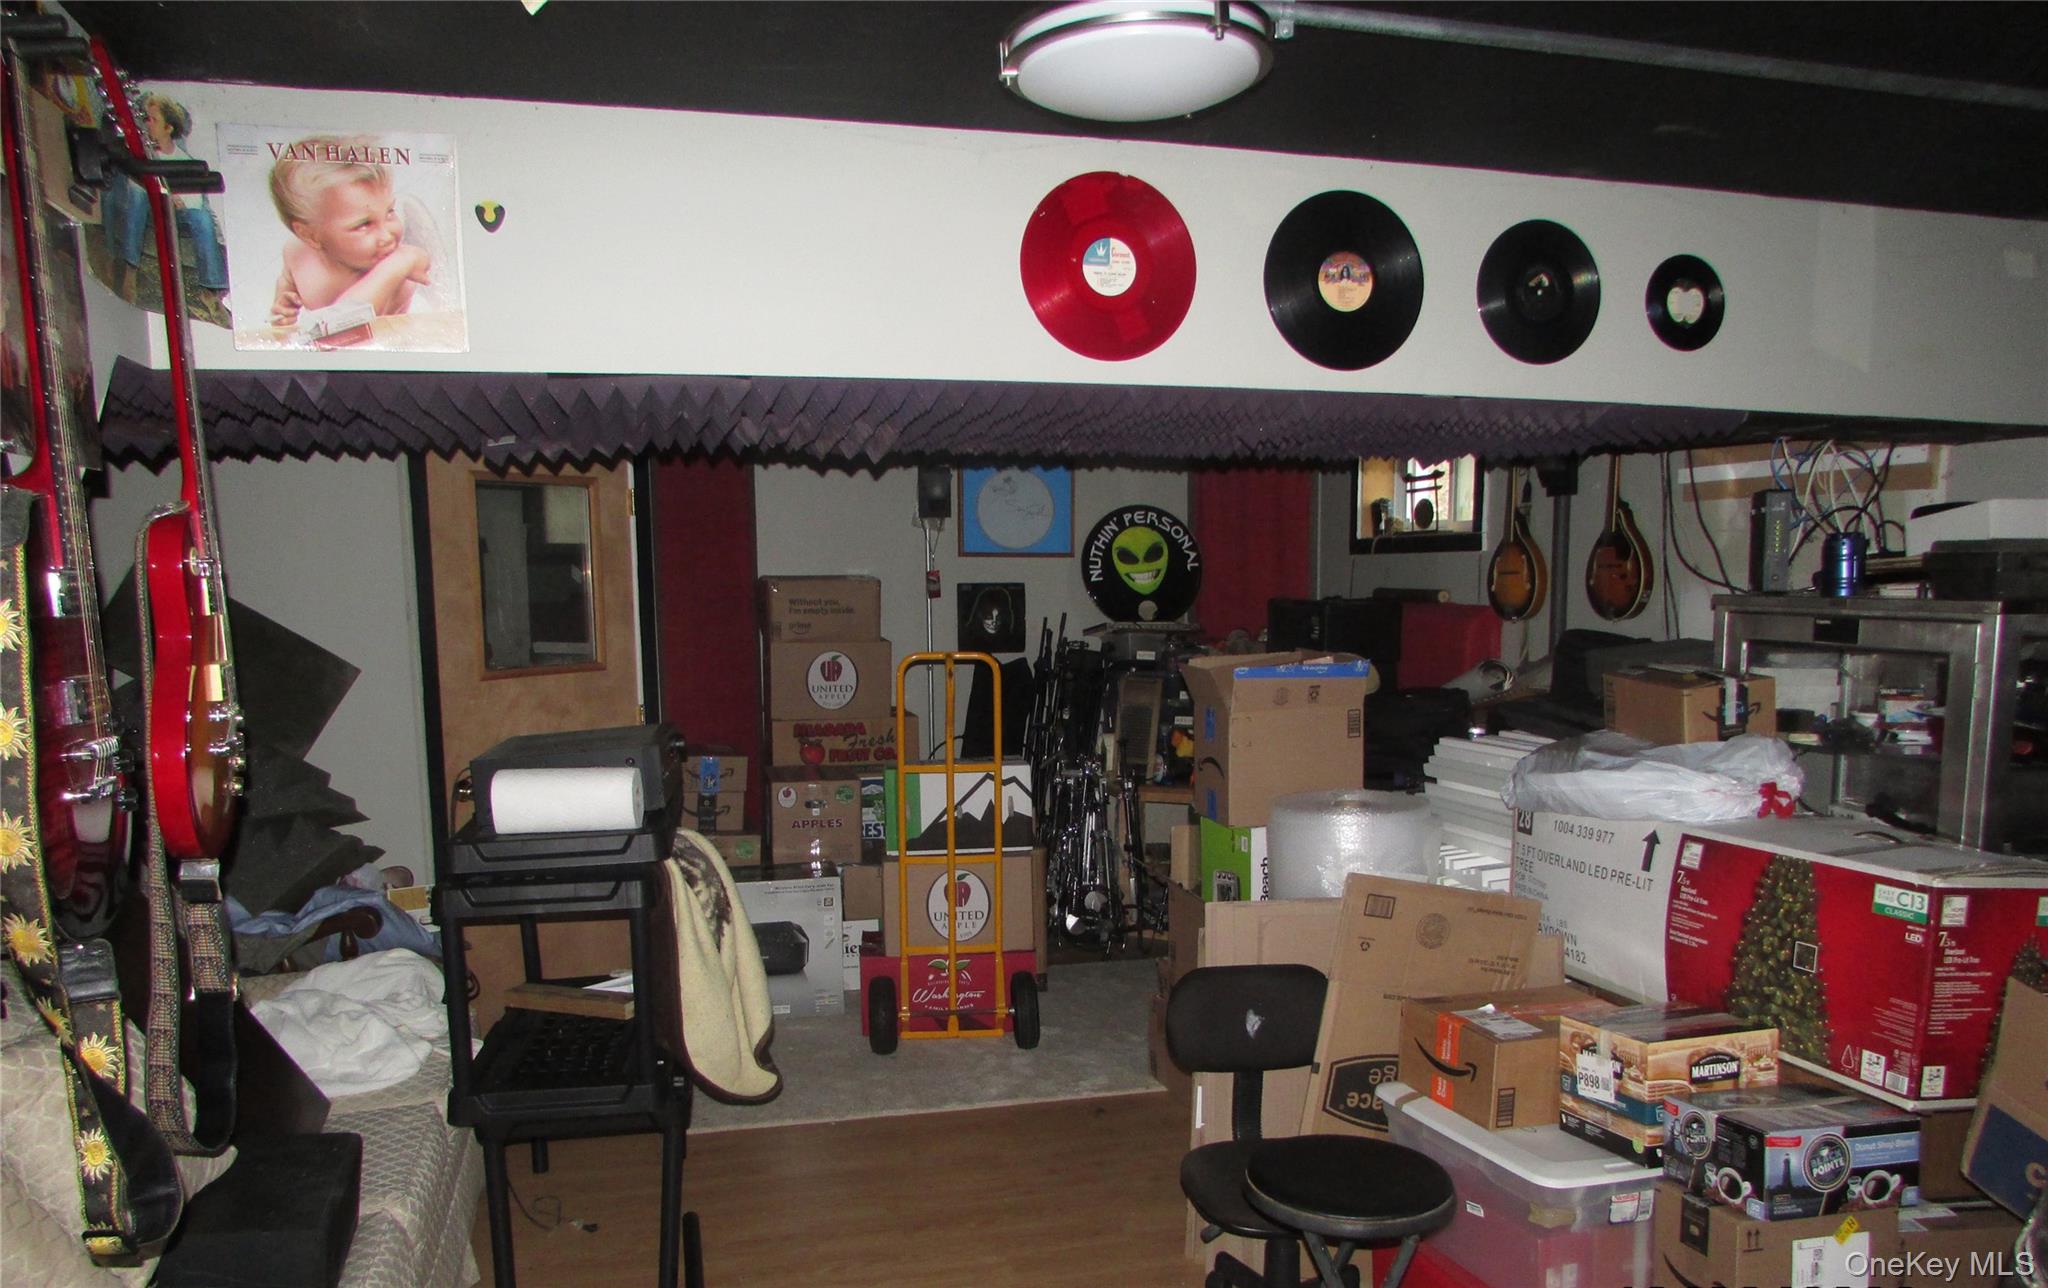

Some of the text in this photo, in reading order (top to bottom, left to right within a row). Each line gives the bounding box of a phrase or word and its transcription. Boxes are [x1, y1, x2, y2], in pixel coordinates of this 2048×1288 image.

[266, 142, 318, 162] VAN
[325, 144, 412, 165] HALEN
[1089, 510, 1199, 581] NUTHIN' PERSONAL
[812, 685, 854, 694] UNITED
[791, 818, 843, 829] APPLES
[1518, 810, 1532, 830] 28
[1553, 819, 1615, 844] 1004 339 977
[1515, 856, 1534, 874] TREE
[1537, 848, 1586, 874] OVERLAND
[1587, 865, 1608, 881] LED
[1609, 868, 1654, 892] PRE-LIT
[1904, 932, 1922, 943] LED
[1691, 1060, 1739, 1079] MARTINSON
[1578, 1071, 1600, 1090] P898
[1812, 1159, 1845, 1178] POINTE
